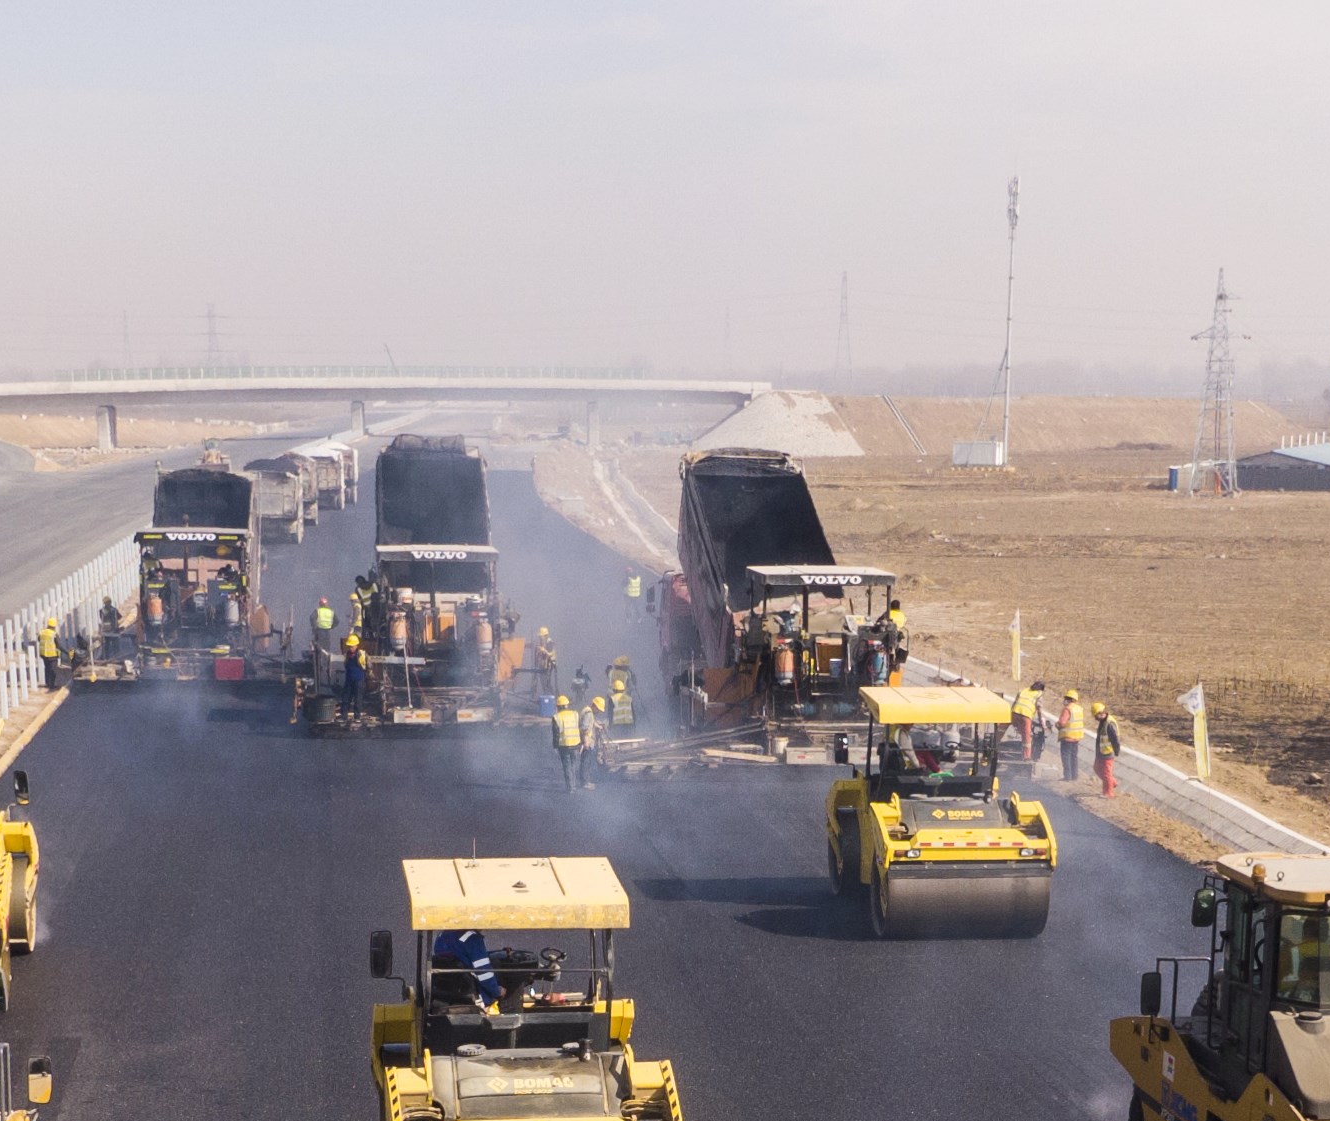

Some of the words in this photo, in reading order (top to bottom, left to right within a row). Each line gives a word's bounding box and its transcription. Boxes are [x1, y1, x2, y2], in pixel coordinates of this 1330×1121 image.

[165, 532, 217, 541] VOLVO
[411, 551, 468, 560] VOLVO
[800, 575, 862, 585] VOLVO
[513, 1076, 574, 1089] BOMAG
